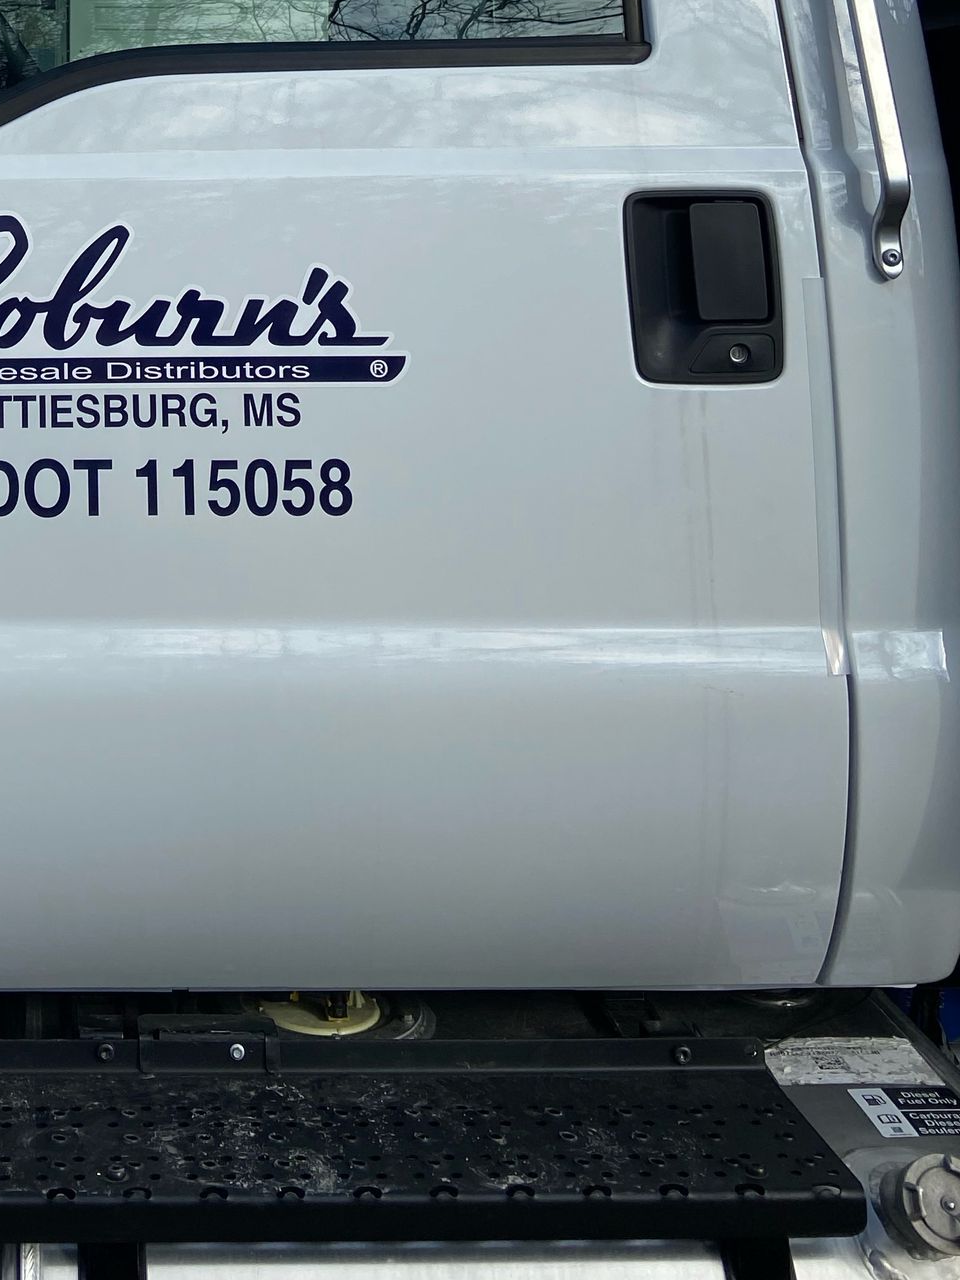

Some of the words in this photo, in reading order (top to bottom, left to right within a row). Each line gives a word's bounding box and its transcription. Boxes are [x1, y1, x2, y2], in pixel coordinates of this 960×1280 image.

[105, 360, 311, 380] Distributors
[242, 392, 302, 428] MS
[134, 458, 355, 518] 115058
[928, 1097, 958, 1106] Only
